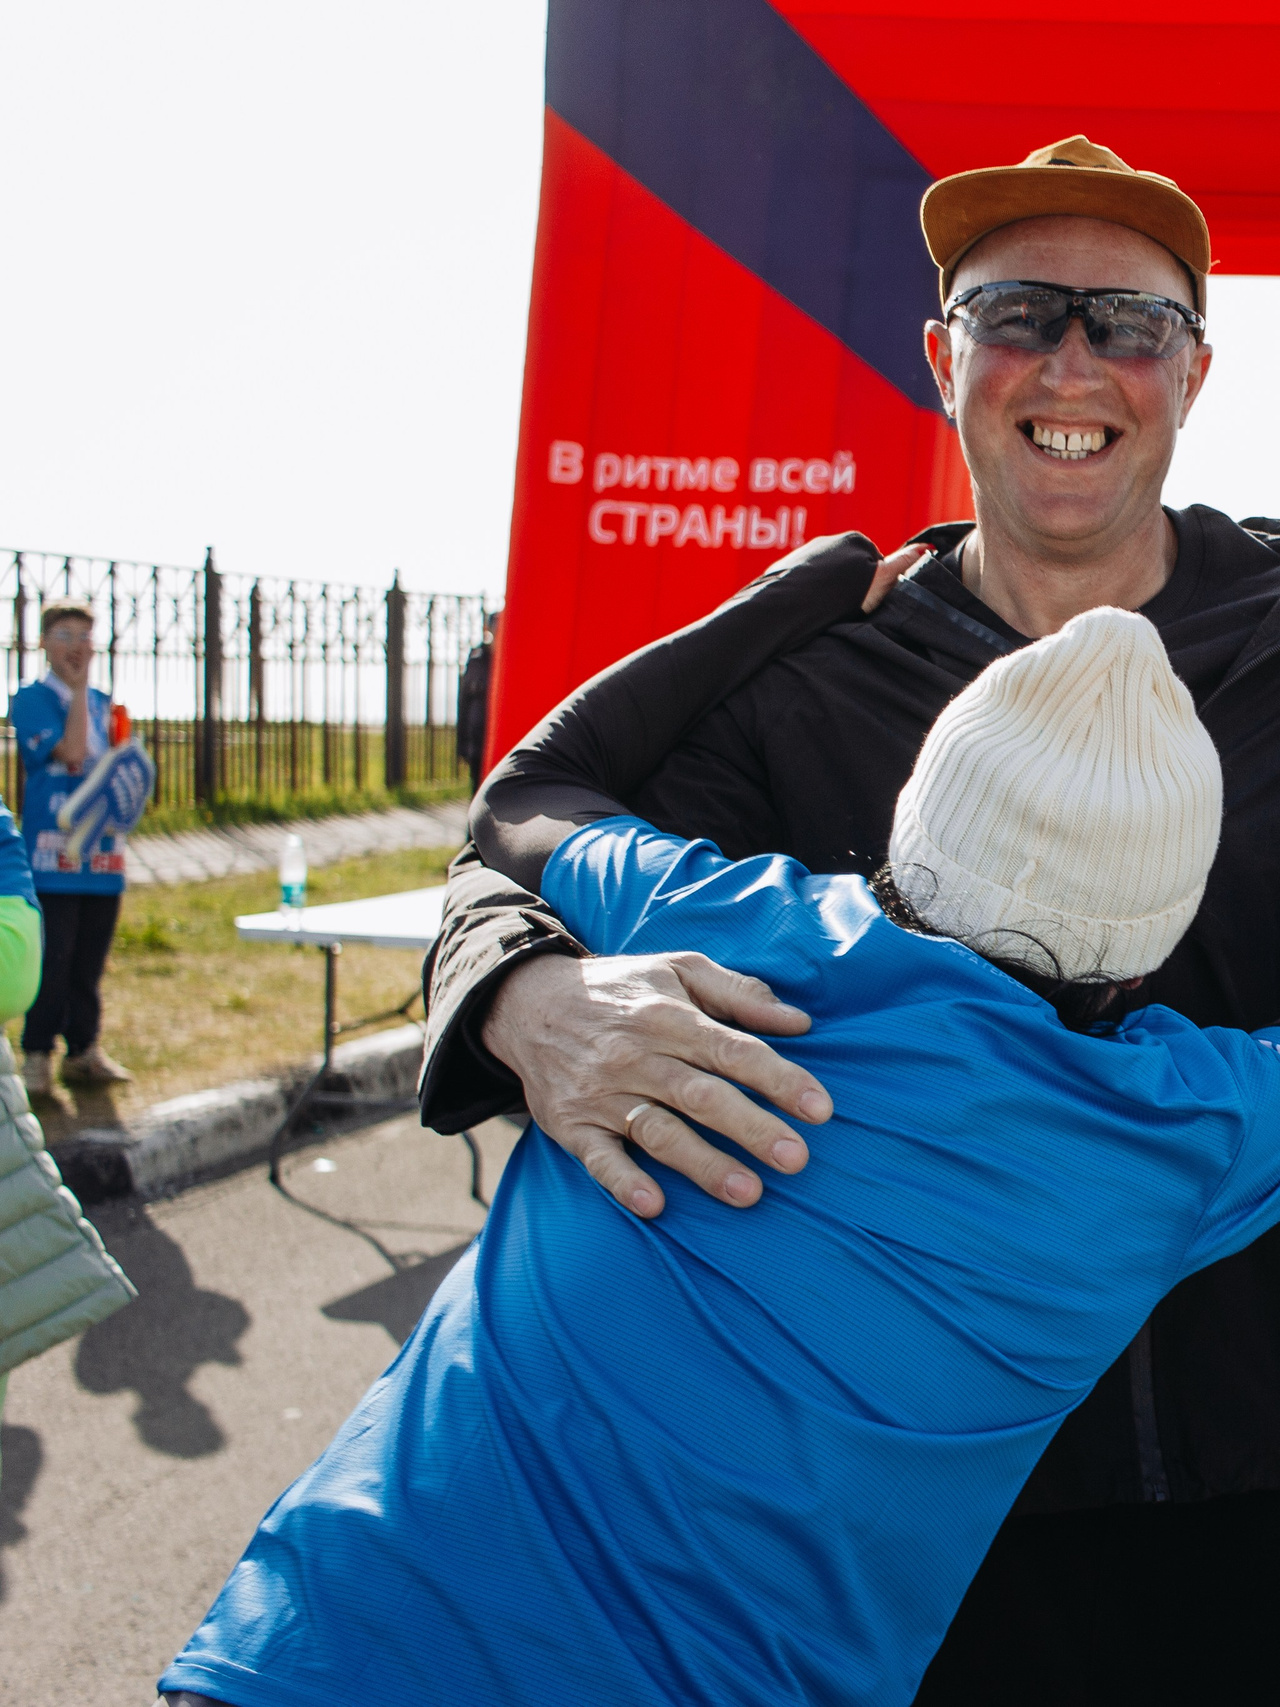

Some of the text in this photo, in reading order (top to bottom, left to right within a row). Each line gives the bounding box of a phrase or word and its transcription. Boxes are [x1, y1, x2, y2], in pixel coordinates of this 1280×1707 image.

[547, 439, 857, 494] В ритме всей
[588, 499, 807, 549] СТРАНЫ!
